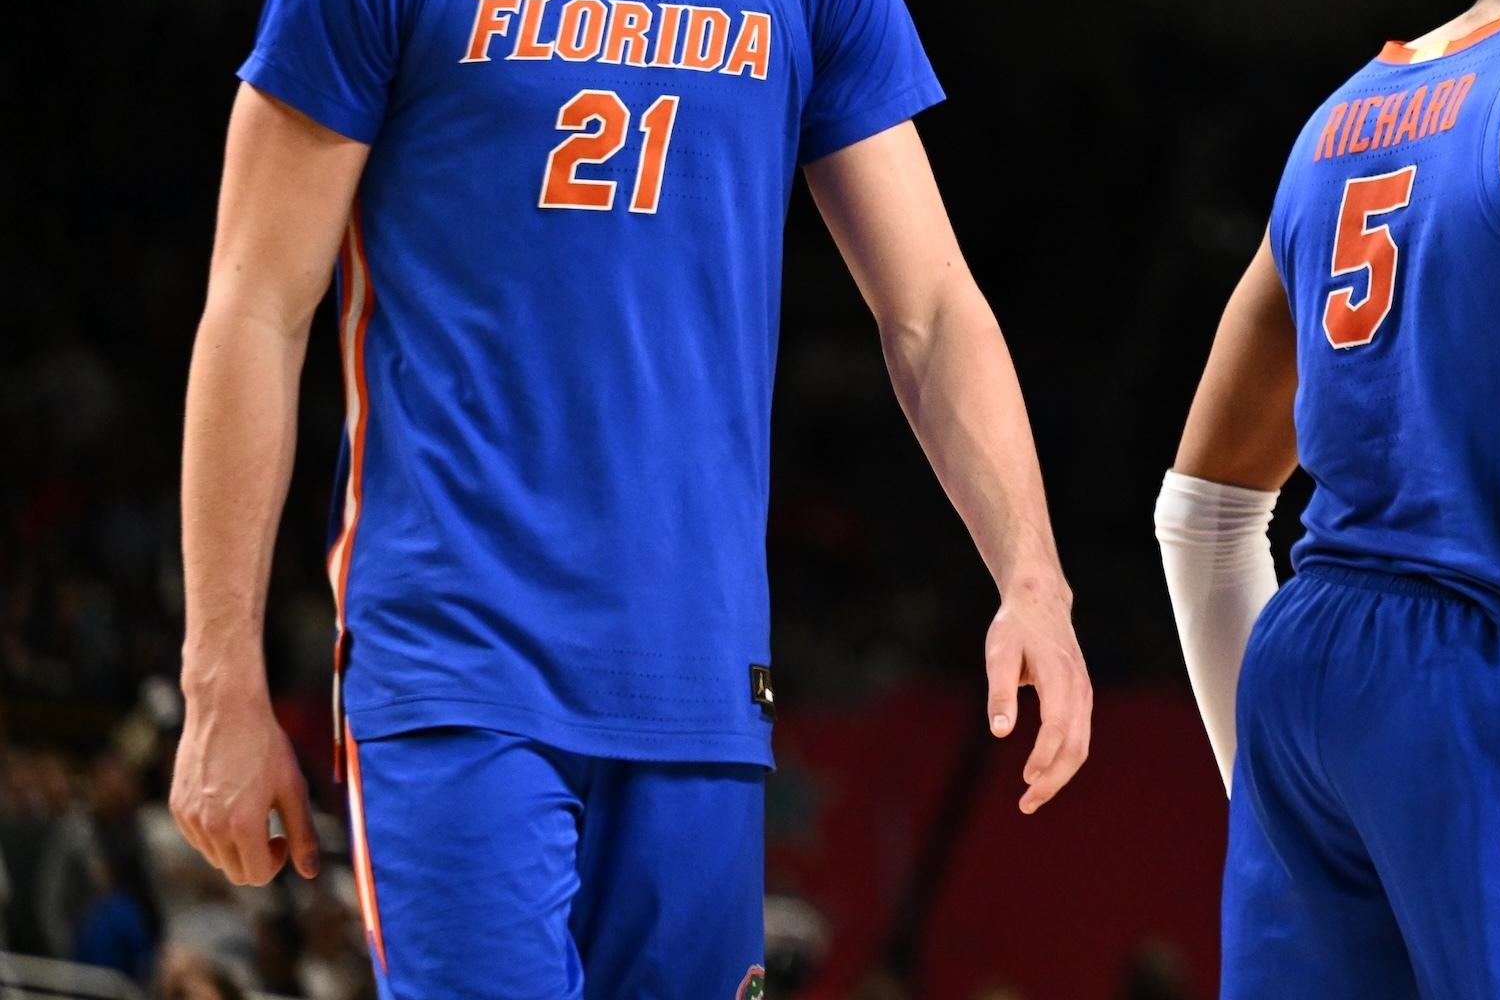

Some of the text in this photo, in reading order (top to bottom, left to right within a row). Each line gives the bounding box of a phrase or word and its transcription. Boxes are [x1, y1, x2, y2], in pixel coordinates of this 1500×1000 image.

[537, 89, 680, 215] 21
[1313, 73, 1477, 162] RICHARD
[1322, 166, 1417, 350] 5
